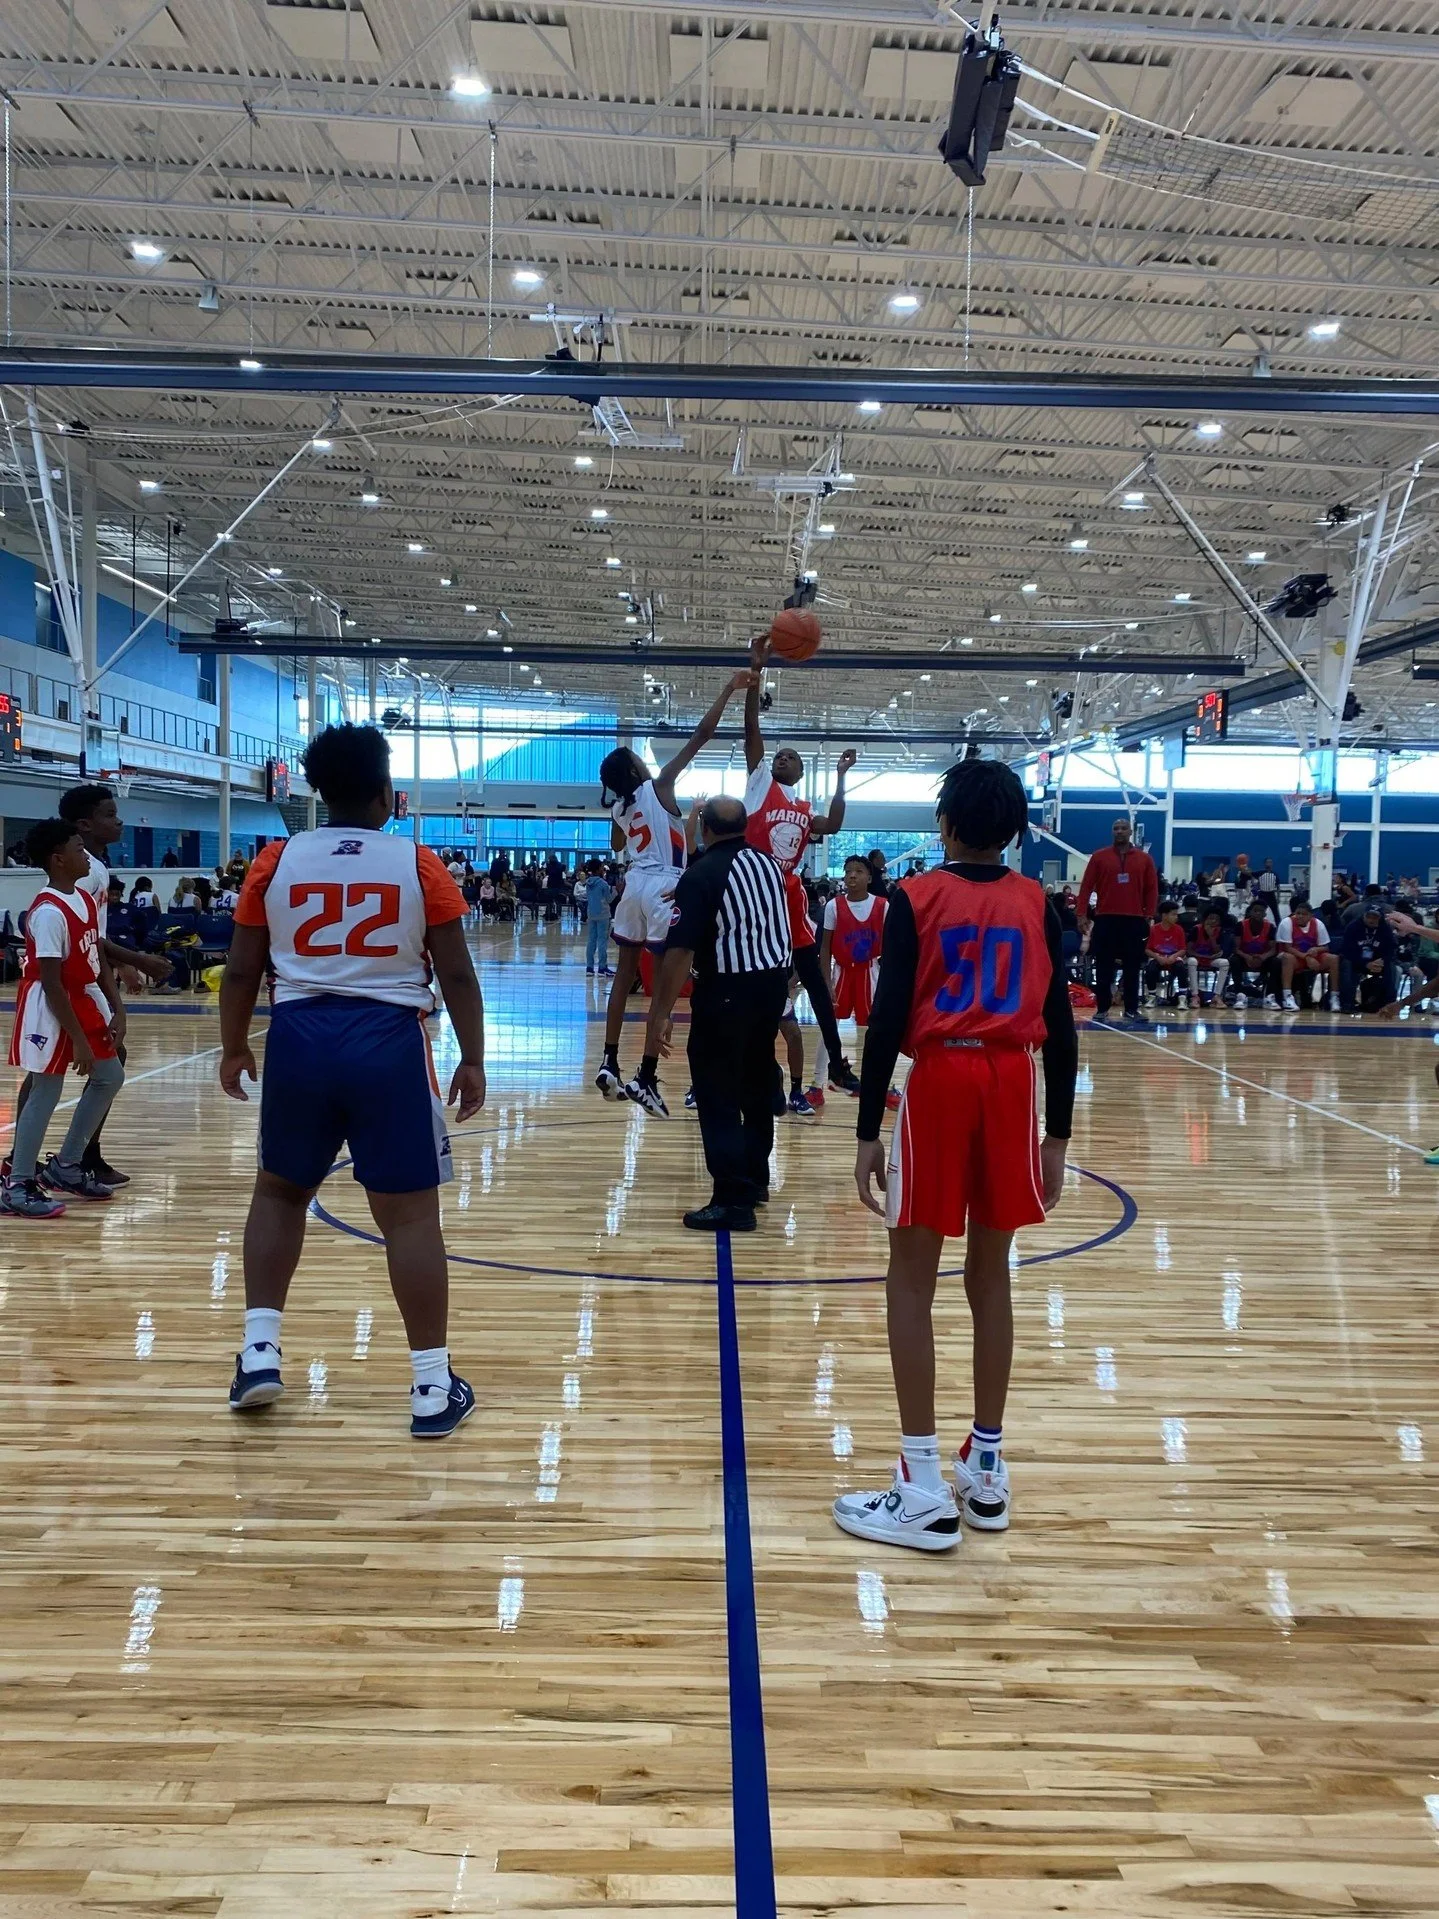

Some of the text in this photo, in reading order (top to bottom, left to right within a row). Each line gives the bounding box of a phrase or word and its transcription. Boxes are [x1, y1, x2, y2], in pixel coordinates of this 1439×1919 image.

[628, 811, 652, 854] 5
[788, 837, 801, 849] 12
[289, 882, 401, 957] 22
[934, 924, 1024, 1014] 50
